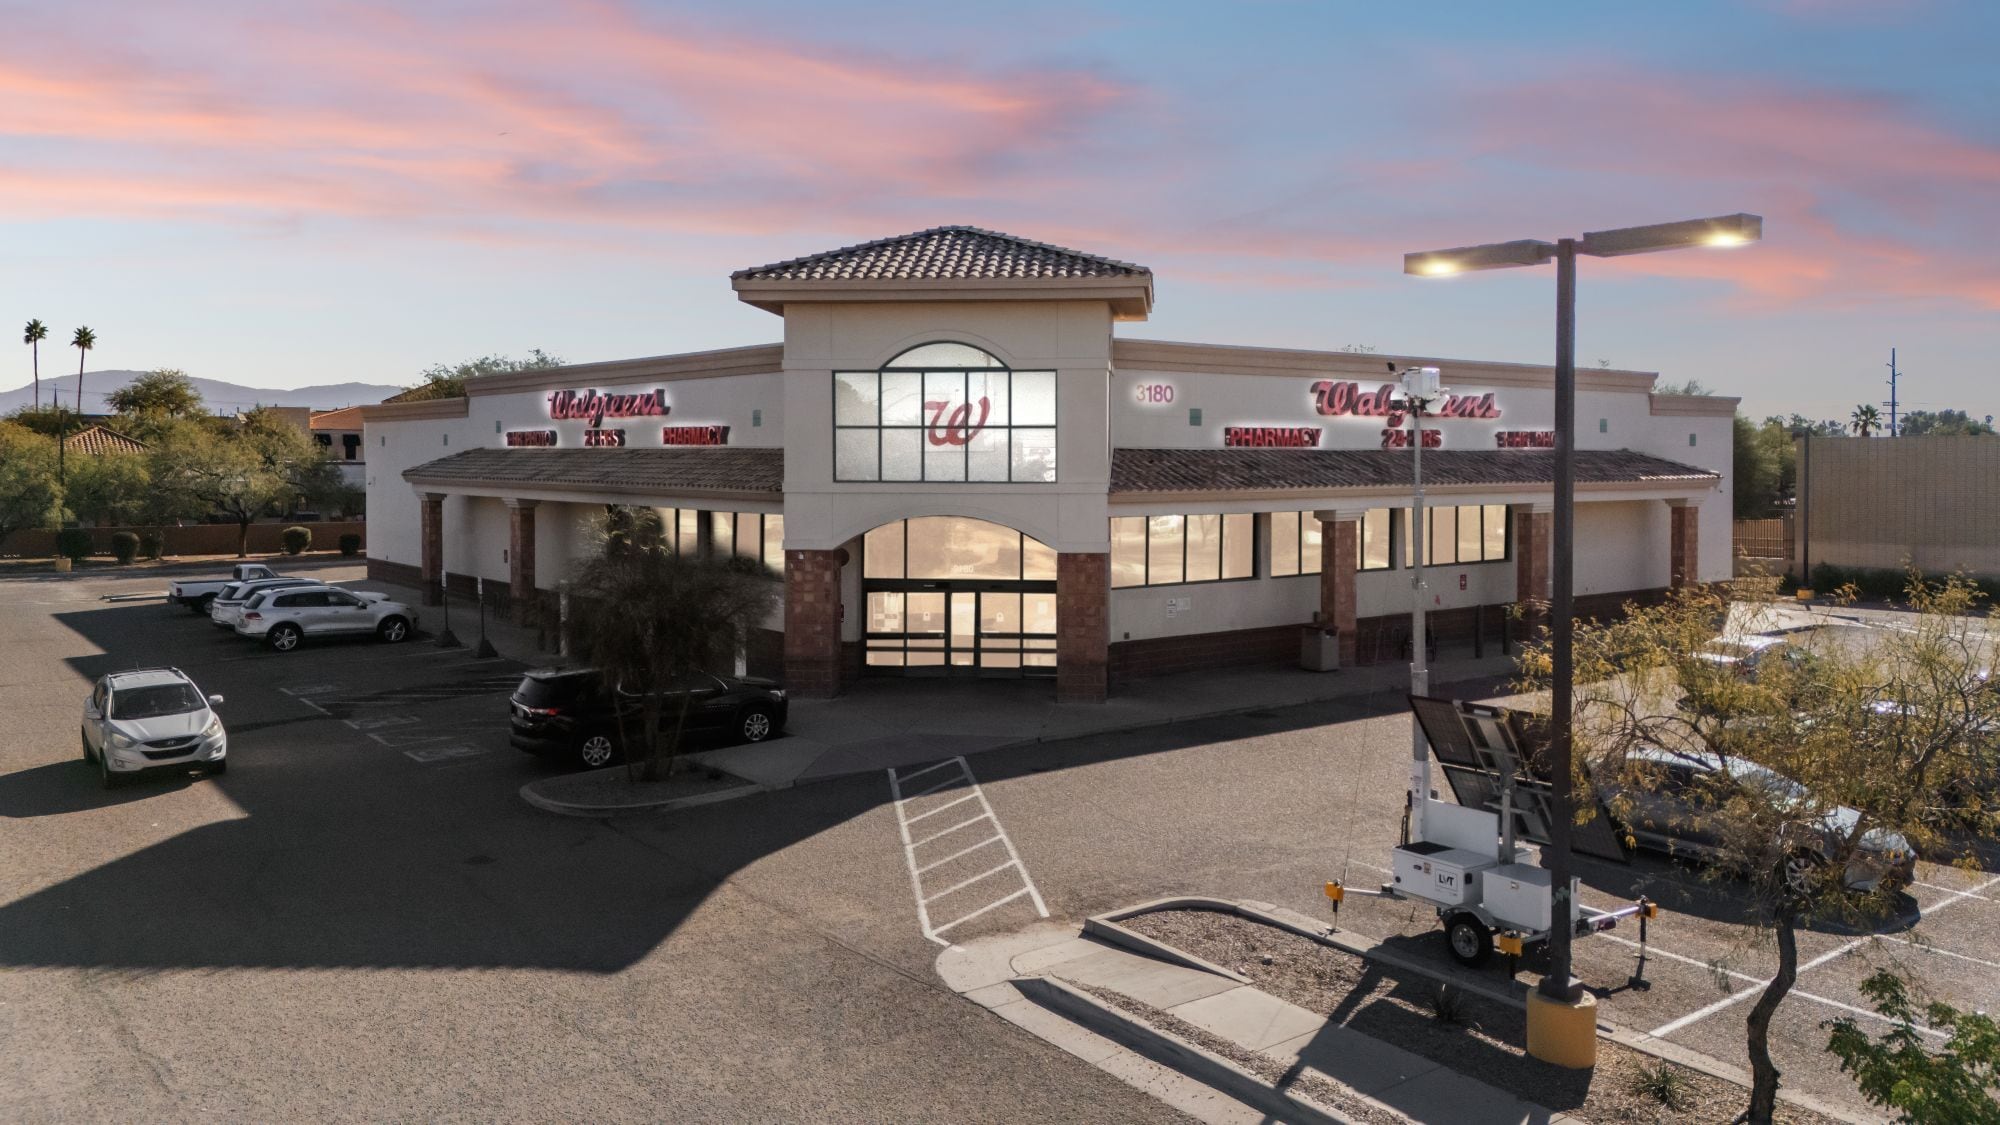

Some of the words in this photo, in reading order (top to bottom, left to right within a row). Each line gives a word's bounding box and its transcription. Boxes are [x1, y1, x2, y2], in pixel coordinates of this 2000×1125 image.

[1136, 384, 1174, 403] 3180
[548, 389, 671, 427] Walgreens
[663, 426, 730, 445] PHARMACY
[1225, 427, 1322, 447] PHARMACY
[1438, 873, 1455, 887] LVT
